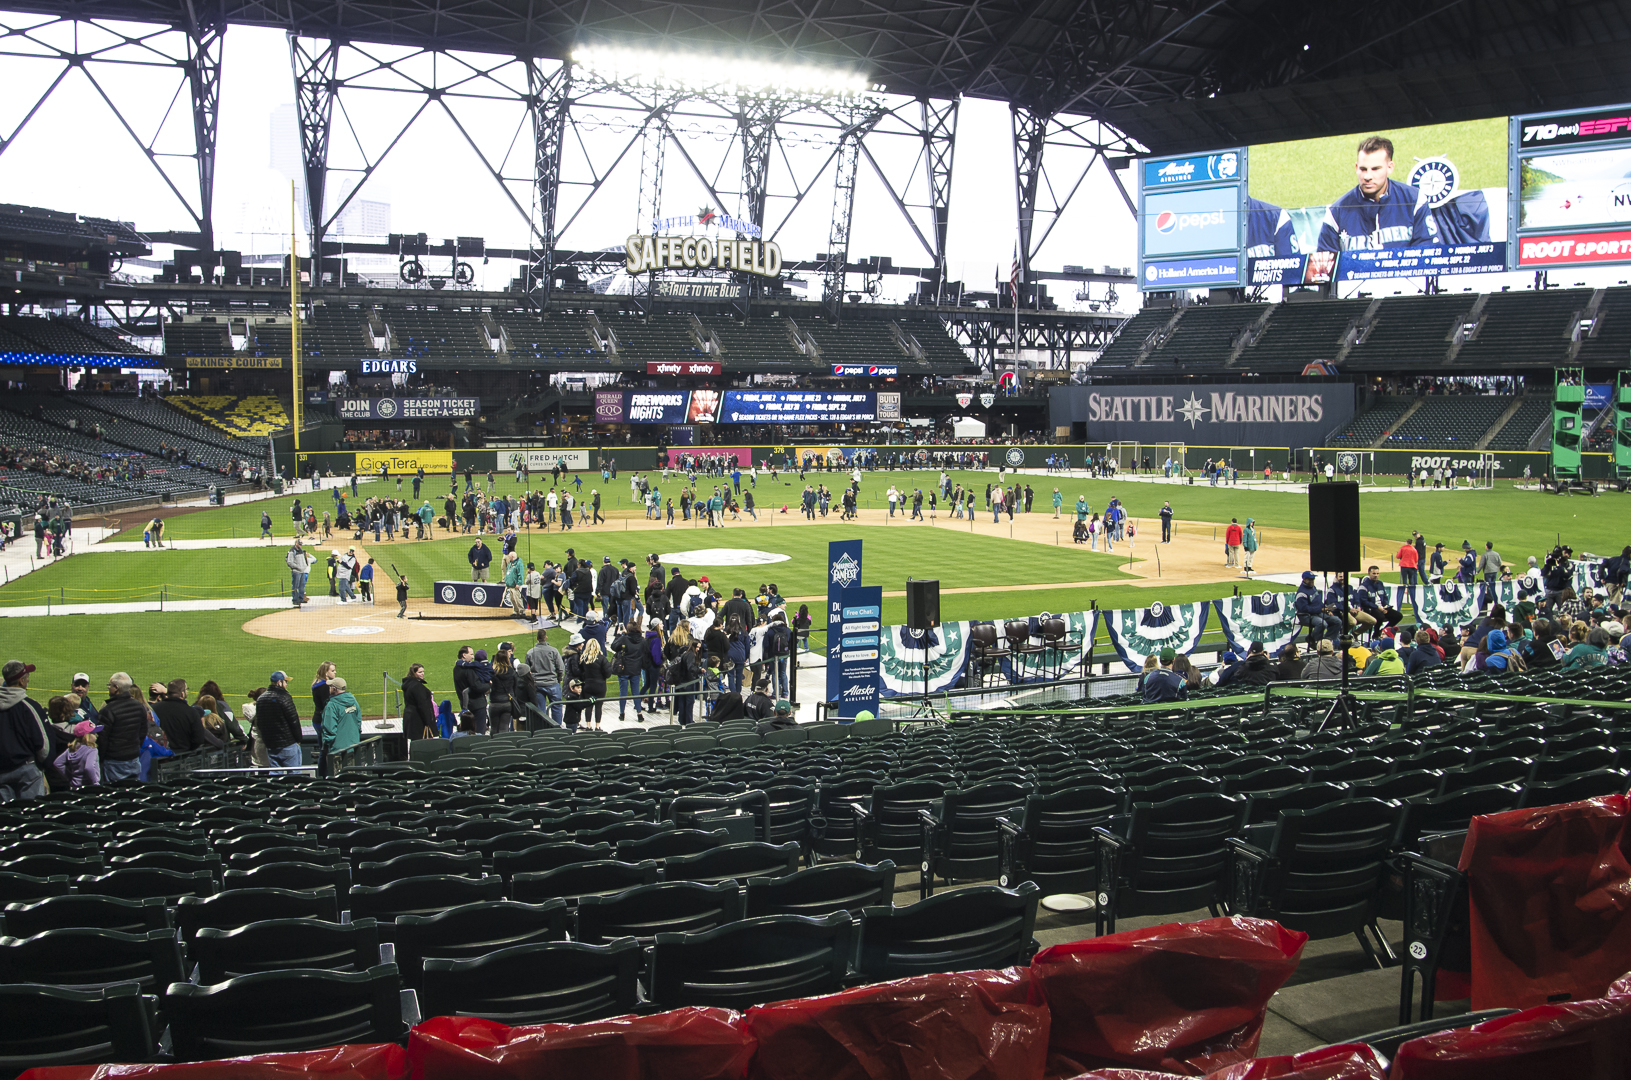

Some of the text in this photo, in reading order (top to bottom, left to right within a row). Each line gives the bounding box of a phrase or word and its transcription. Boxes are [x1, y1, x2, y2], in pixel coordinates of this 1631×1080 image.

[1523, 124, 1558, 141] 710
[1579, 116, 1631, 135] ESP
[1179, 208, 1225, 231] pepsi
[652, 214, 761, 239] SEATTLE MARINERS
[626, 233, 783, 278] SAFECO FIELD
[1522, 239, 1631, 259] ROOT SPORT
[1158, 264, 1237, 278] Holland America Line
[1254, 258, 1300, 271] FIREWORKS
[1252, 270, 1283, 283] NIGHTS
[669, 282, 742, 298] TRUE TO THE BLUE
[200, 358, 268, 367] KING'S COURT
[657, 364, 714, 374] xfinity xfinity
[844, 367, 898, 376] pepsi pepsi
[341, 400, 370, 411] JOIN
[404, 400, 475, 408] SEASON TICKET
[631, 394, 684, 406] FIREWORKS
[404, 408, 475, 417] SELECT-A-SEAT
[630, 406, 664, 420] NIGHTS
[1089, 392, 1323, 424] SEATTLE MARINERS
[361, 458, 418, 473] GigaTera
[1411, 457, 1501, 470] ROOT SPORTS
[843, 684, 876, 697] Alaska
[1101, 894, 1107, 903] 20
[1413, 945, 1424, 956] 22
